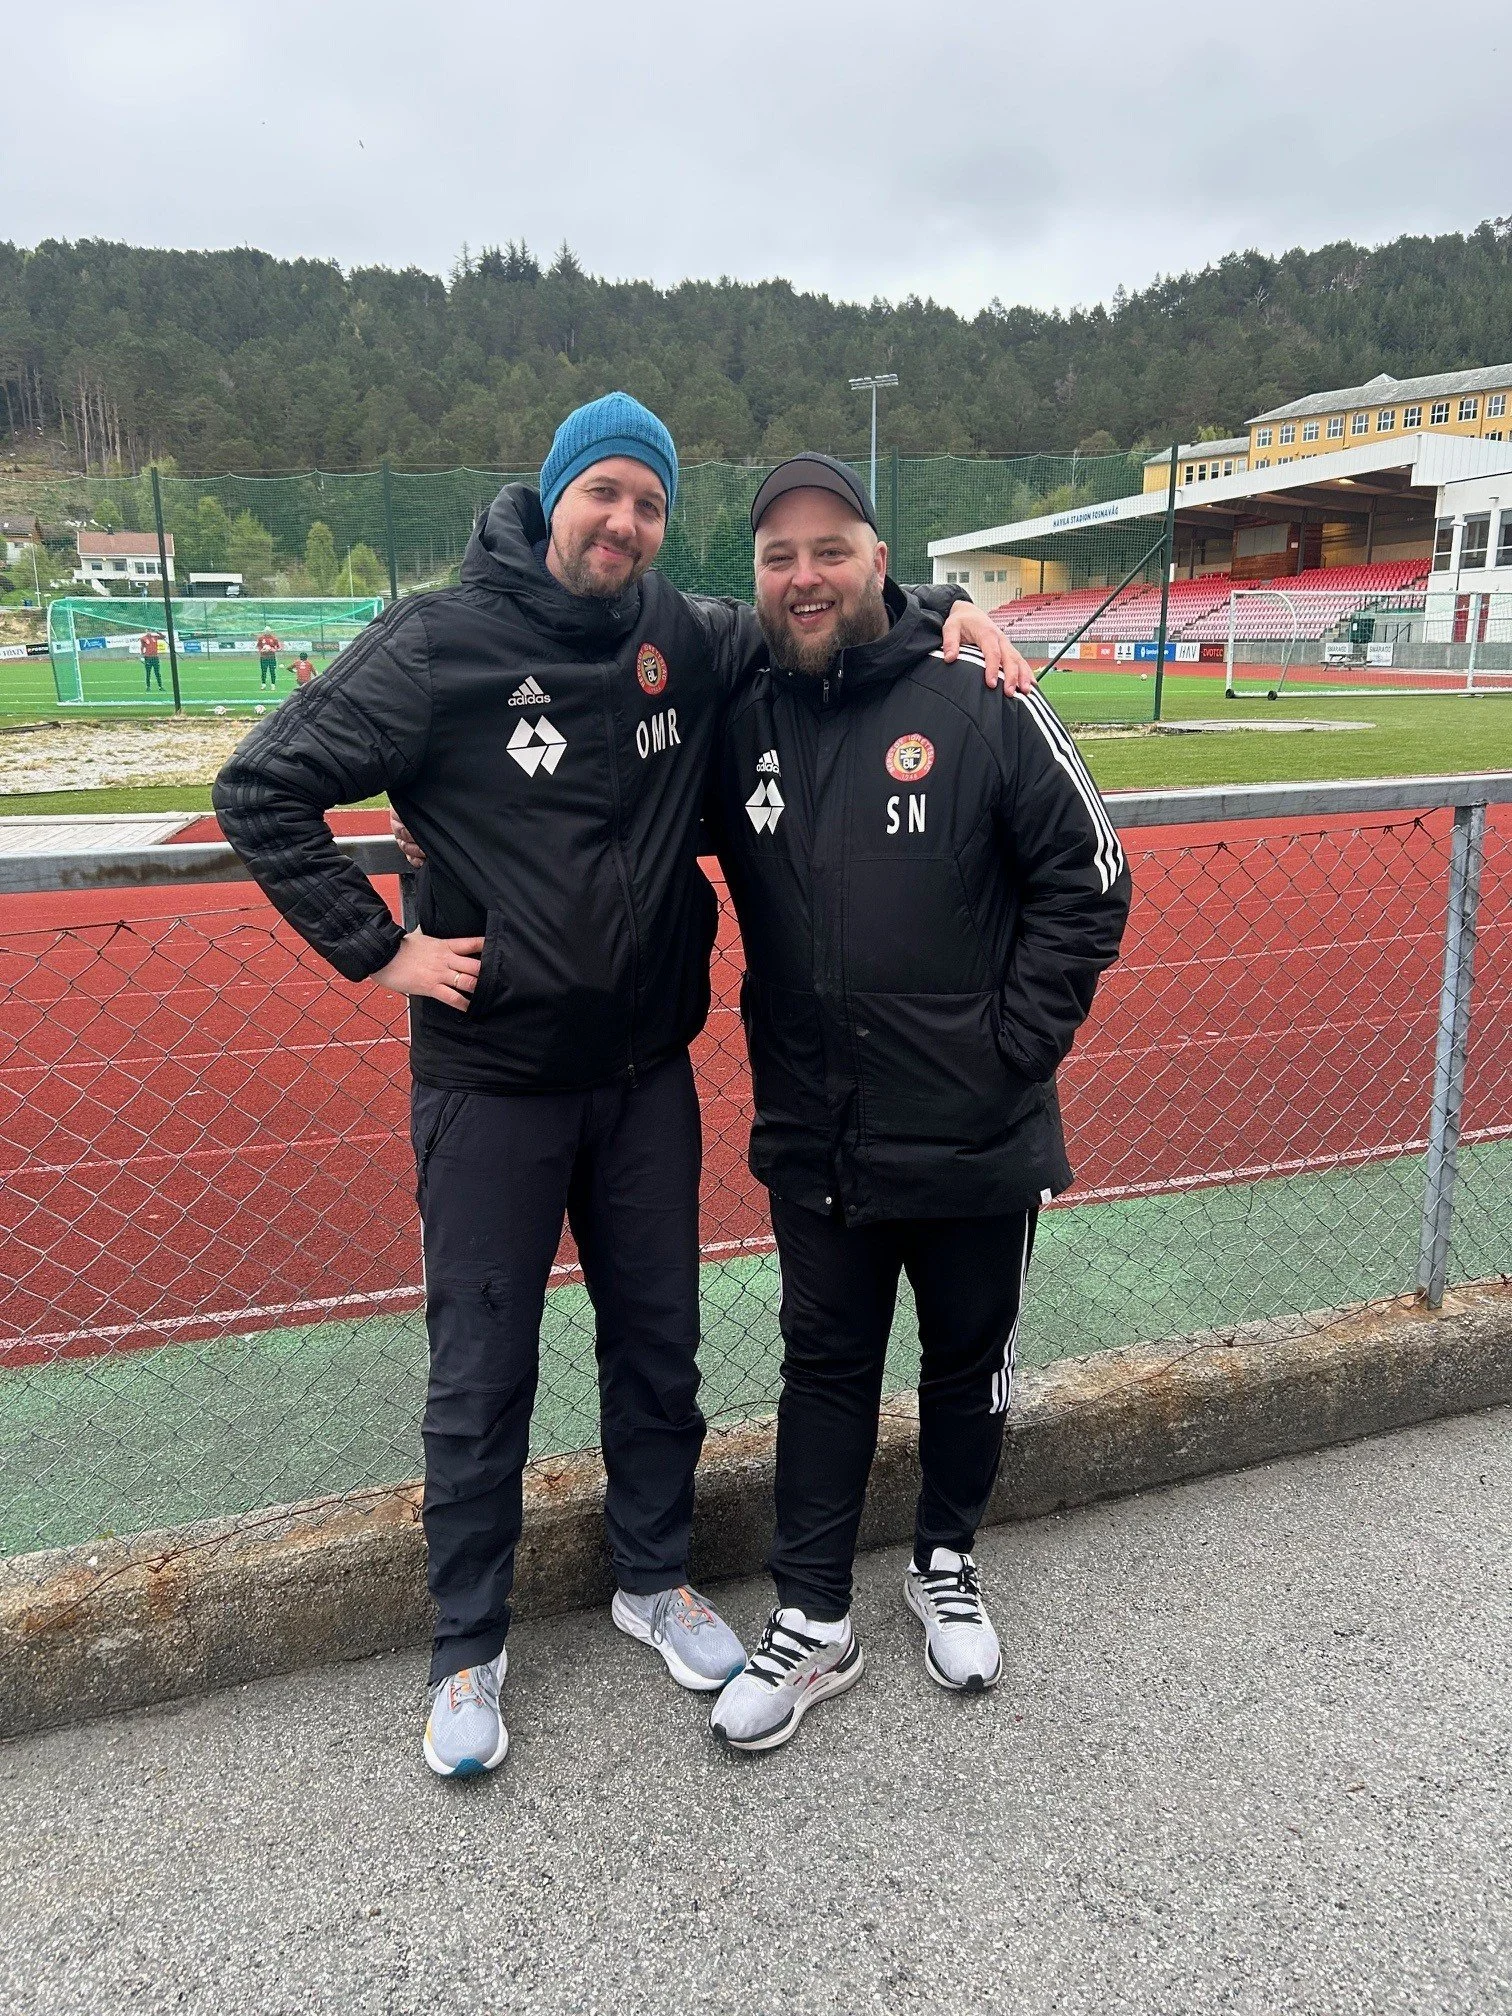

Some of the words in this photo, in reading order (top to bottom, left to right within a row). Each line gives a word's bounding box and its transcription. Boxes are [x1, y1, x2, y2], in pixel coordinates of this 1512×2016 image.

[1071, 512, 1091, 524] STADION
[1092, 505, 1118, 519] FOSNAVÅG
[508, 694, 551, 707] adidas
[636, 707, 682, 759] OMR
